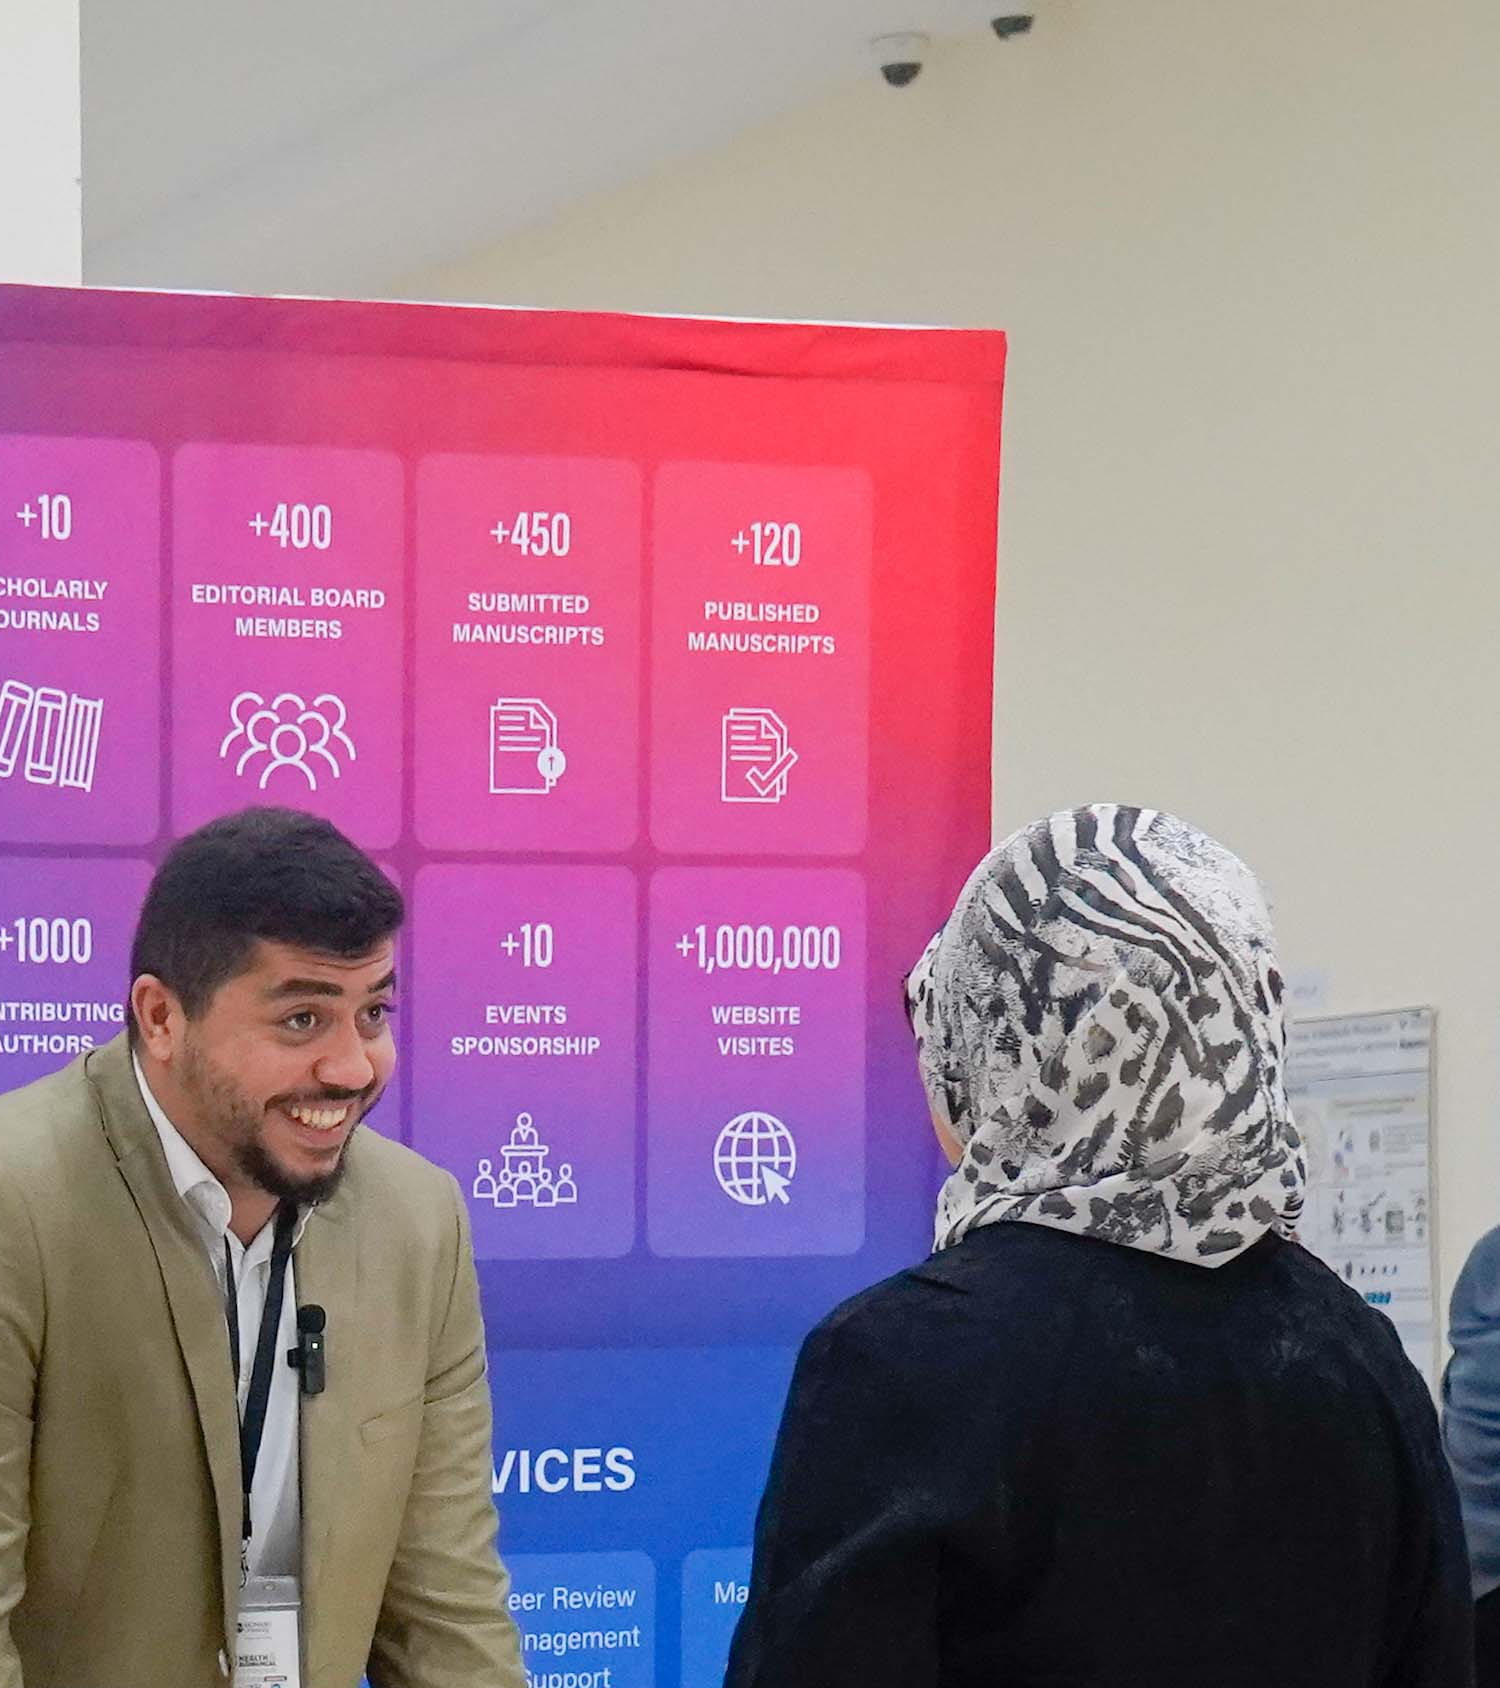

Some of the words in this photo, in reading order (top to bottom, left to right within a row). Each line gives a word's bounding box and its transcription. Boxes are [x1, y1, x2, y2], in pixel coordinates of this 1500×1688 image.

[16, 494, 73, 542] +10
[248, 503, 332, 551] +400
[489, 511, 571, 558] +450
[730, 521, 802, 568] +120
[192, 585, 304, 609] EDITORIAL
[309, 587, 386, 611] BOARD
[468, 592, 590, 616] SUBMITTED
[704, 601, 820, 625] PUBLISHED
[235, 617, 343, 641] MEMBERS
[452, 623, 605, 647] MANUSCRIPTS
[687, 632, 836, 656] MANUSCRIPTS
[500, 923, 554, 969] +10
[675, 925, 842, 974] +1,000,000
[486, 1005, 567, 1027] EVENTS
[712, 1006, 801, 1027] WEBSITE
[451, 1036, 601, 1058] SPONSORSHIP
[717, 1036, 794, 1057] VISITES
[491, 1447, 637, 1494] VICES
[508, 1590, 545, 1611] eer
[553, 1585, 636, 1609] Review
[523, 1626, 640, 1656] nagement
